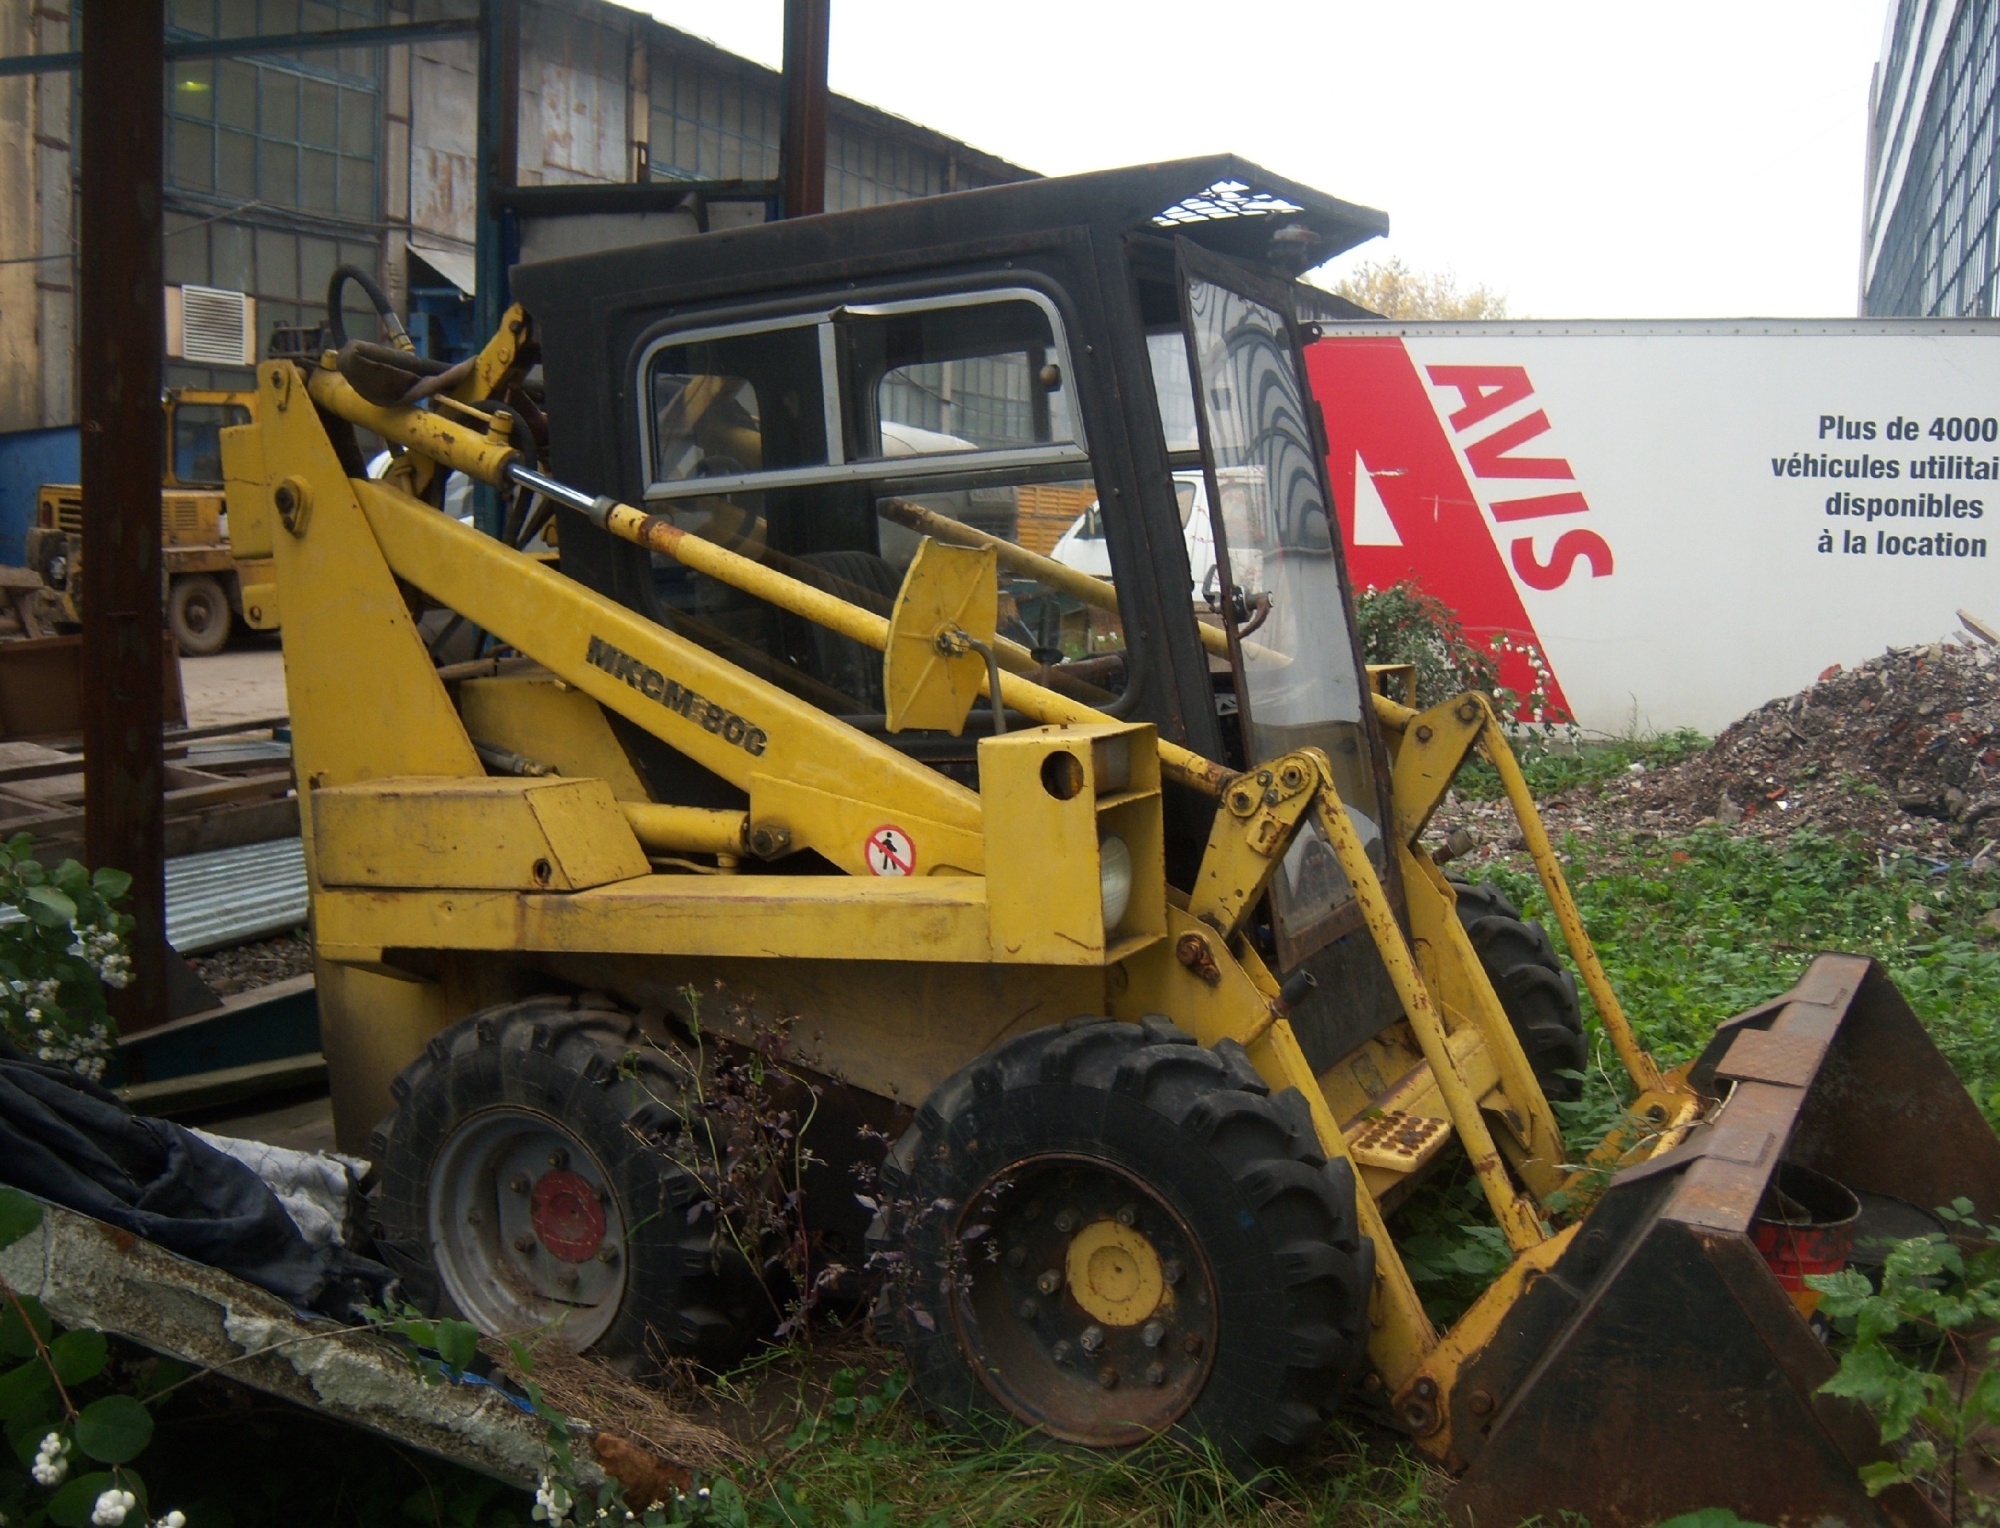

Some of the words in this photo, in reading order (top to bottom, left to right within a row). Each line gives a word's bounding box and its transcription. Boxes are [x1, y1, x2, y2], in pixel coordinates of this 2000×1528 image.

[1818, 415, 1877, 440] Plus
[1886, 416, 1919, 441] de
[1928, 417, 1998, 442] 4000
[1425, 365, 1614, 591] AVIS
[1771, 452, 1900, 478] véhicules
[1910, 455, 2000, 480] utilitai
[1825, 491, 1984, 521] disponibles
[1817, 528, 1833, 553] à
[1843, 529, 1867, 554] la
[1876, 530, 1987, 557] location
